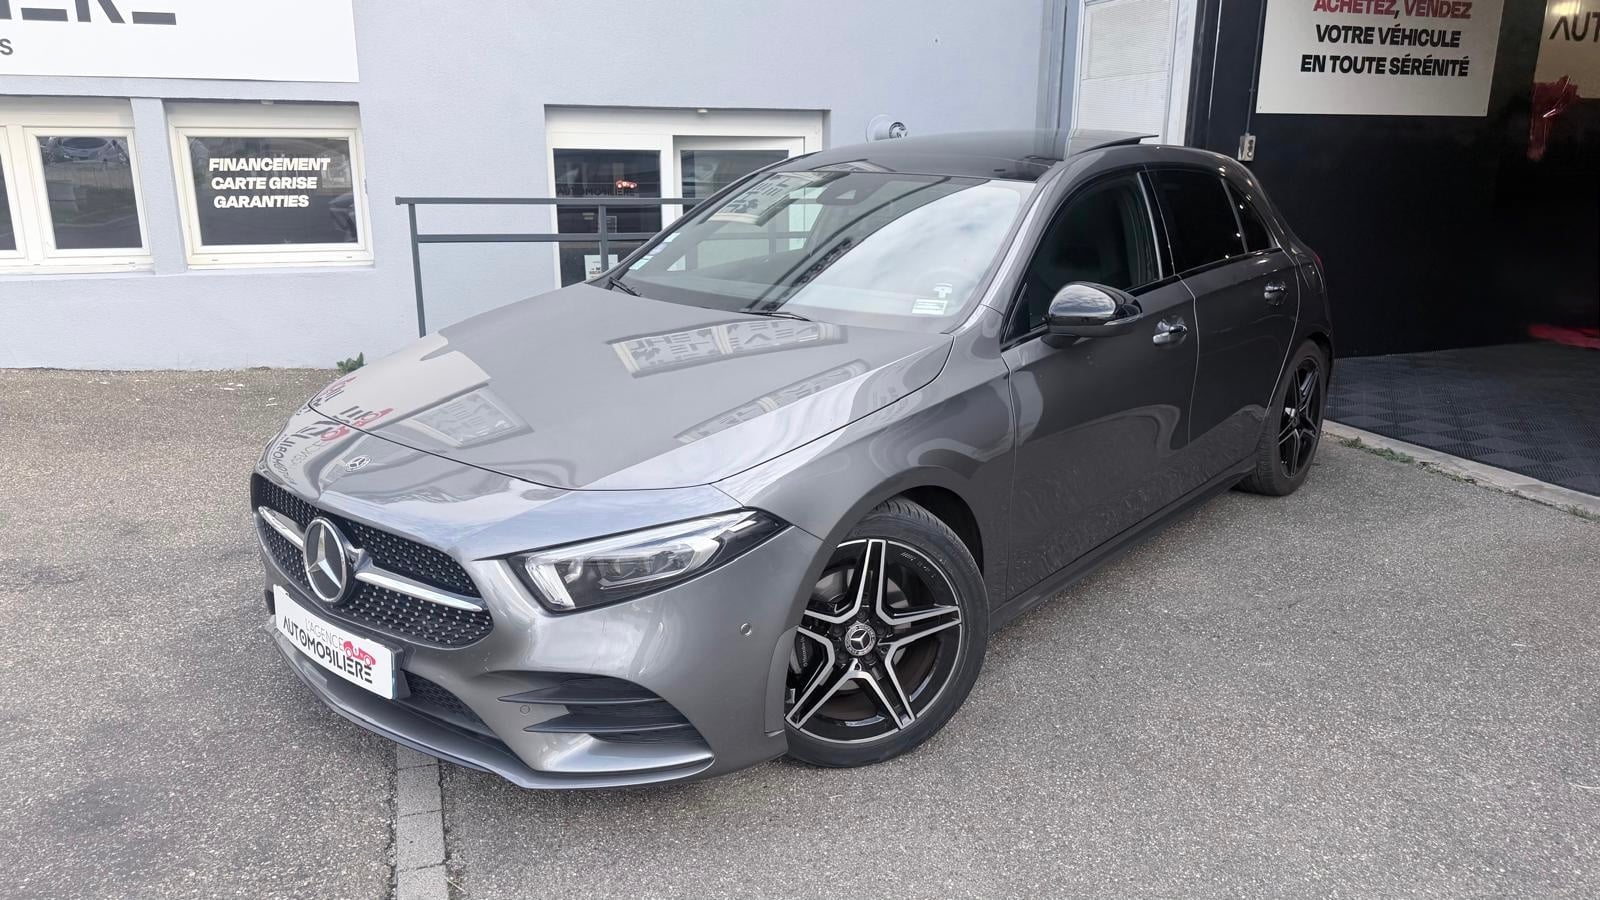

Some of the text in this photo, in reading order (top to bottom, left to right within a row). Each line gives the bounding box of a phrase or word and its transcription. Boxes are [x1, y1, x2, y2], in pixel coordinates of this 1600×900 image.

[1313, 0, 1473, 19] ACHETEZ, VENDEZ
[1315, 23, 1462, 48] VOTRE VÉHICULE
[1300, 53, 1470, 77] EN TOUTE SÉRÉNITÉ
[208, 157, 331, 172] FINANCEMENT
[211, 176, 318, 190] CARTE GRISE
[213, 195, 310, 209] GARANTIES
[304, 617, 345, 652] L'AGENCE
